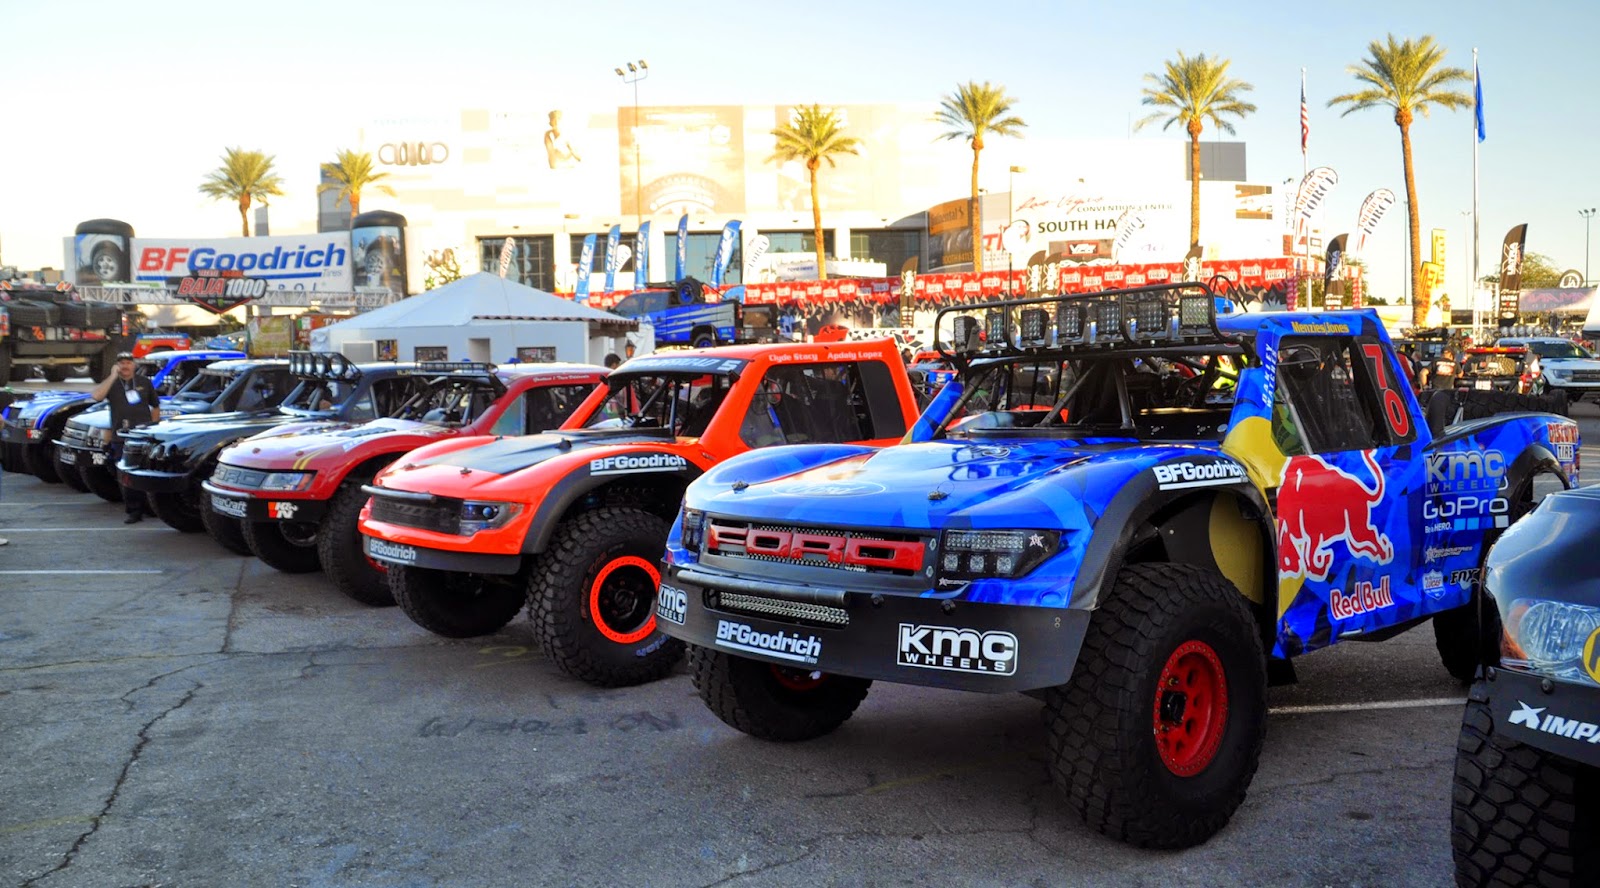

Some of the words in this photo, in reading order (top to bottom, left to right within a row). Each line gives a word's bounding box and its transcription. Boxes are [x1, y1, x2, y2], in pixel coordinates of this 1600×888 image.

[1302, 177, 1335, 218] FORCE
[1077, 205, 1135, 213] CONVENTION
[1364, 198, 1392, 234] FORCE
[1038, 220, 1088, 233] SOUTH
[138, 242, 346, 272] BFGoodrich
[179, 277, 225, 296] BAJA
[225, 279, 265, 298] 1000
[769, 354, 791, 363] Clyde
[793, 353, 818, 362] Stacy
[858, 351, 883, 359] Lopez
[1361, 343, 1410, 438] 70
[590, 454, 687, 471] BFGoodrich
[1558, 445, 1573, 459] TIRE
[1152, 460, 1248, 484] BFGoodrich
[1430, 478, 1501, 493] WHEELS
[274, 501, 299, 519] K&N
[1423, 496, 1508, 519] GoPro
[370, 538, 416, 560] BFGoodrich
[708, 524, 926, 571] FORD
[1330, 581, 1366, 620] Red
[1361, 575, 1395, 613] Bull
[716, 619, 822, 657] BFGoodrich
[905, 652, 1007, 672] WHEELS
